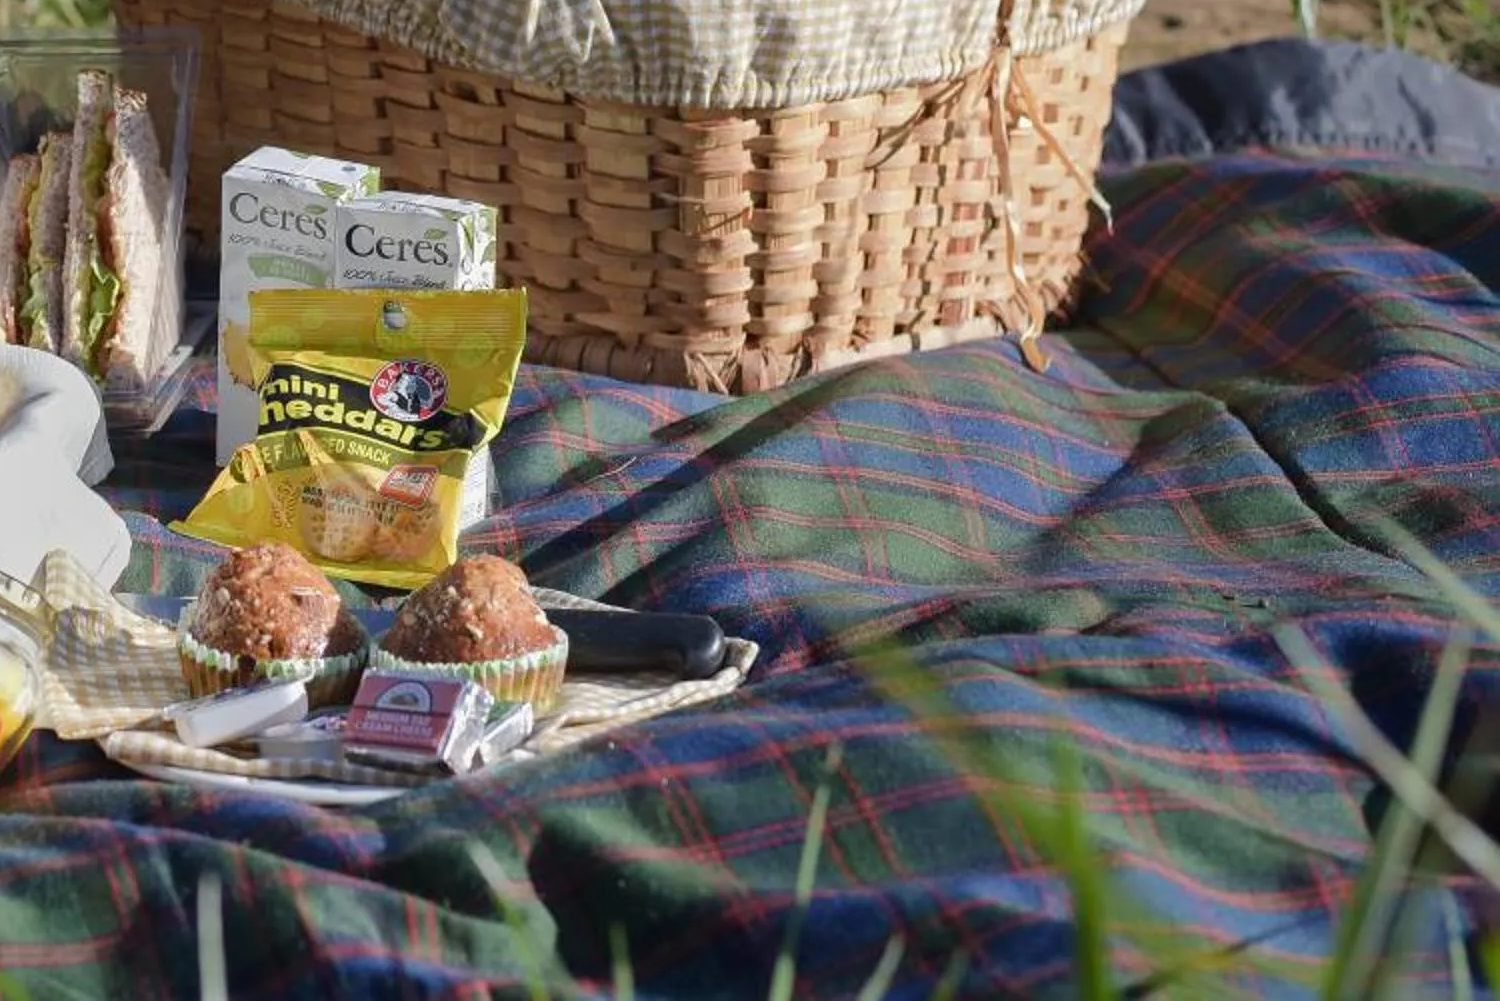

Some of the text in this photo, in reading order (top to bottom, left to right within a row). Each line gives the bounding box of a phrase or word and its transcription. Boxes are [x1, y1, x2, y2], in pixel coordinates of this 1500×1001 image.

[229, 192, 328, 241] Ceres
[345, 223, 449, 267] Ceres
[259, 398, 443, 449] heddars
[347, 440, 392, 466] SNACK
